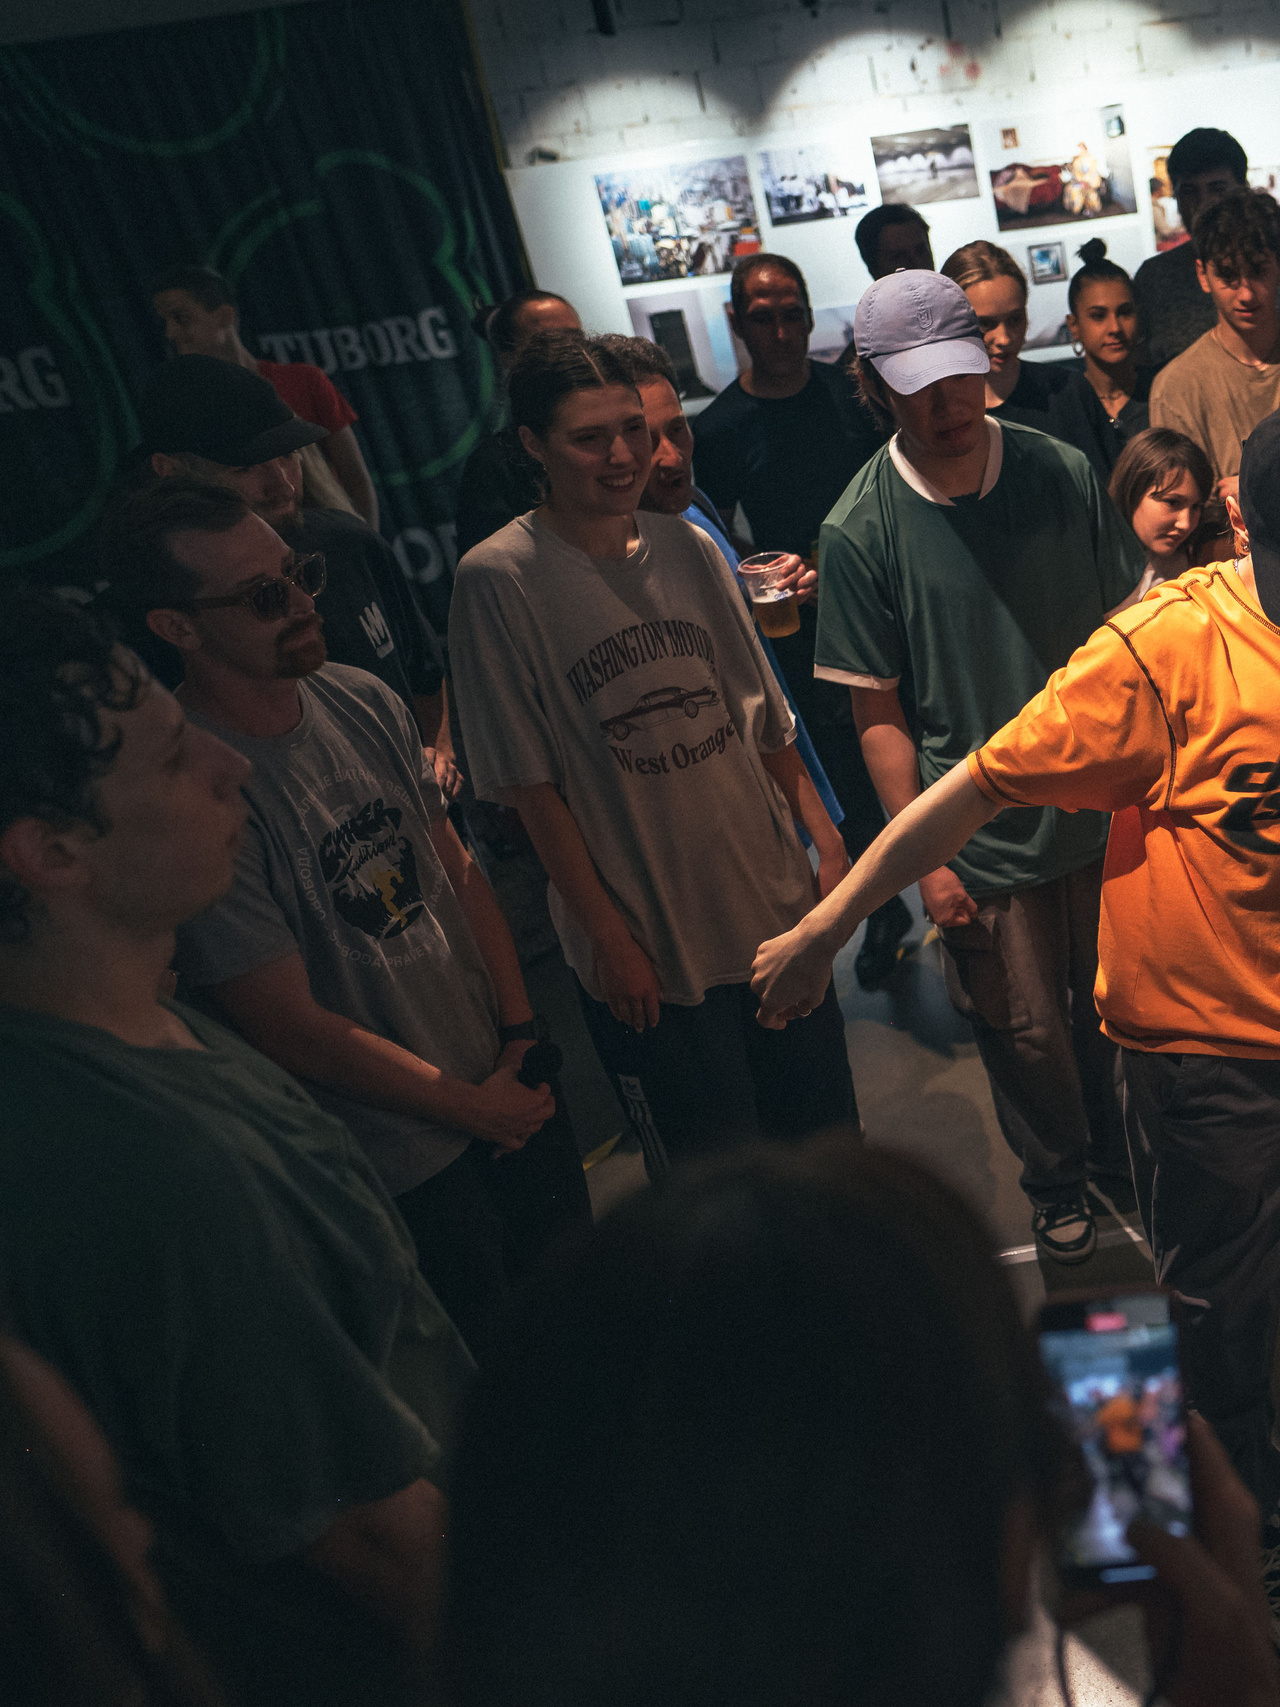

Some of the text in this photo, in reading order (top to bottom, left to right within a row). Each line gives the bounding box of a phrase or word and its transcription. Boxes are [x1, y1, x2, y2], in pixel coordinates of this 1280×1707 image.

[259, 307, 457, 377] TUBORG
[566, 620, 669, 707] WASHINGTON
[608, 719, 735, 774] West Orange
